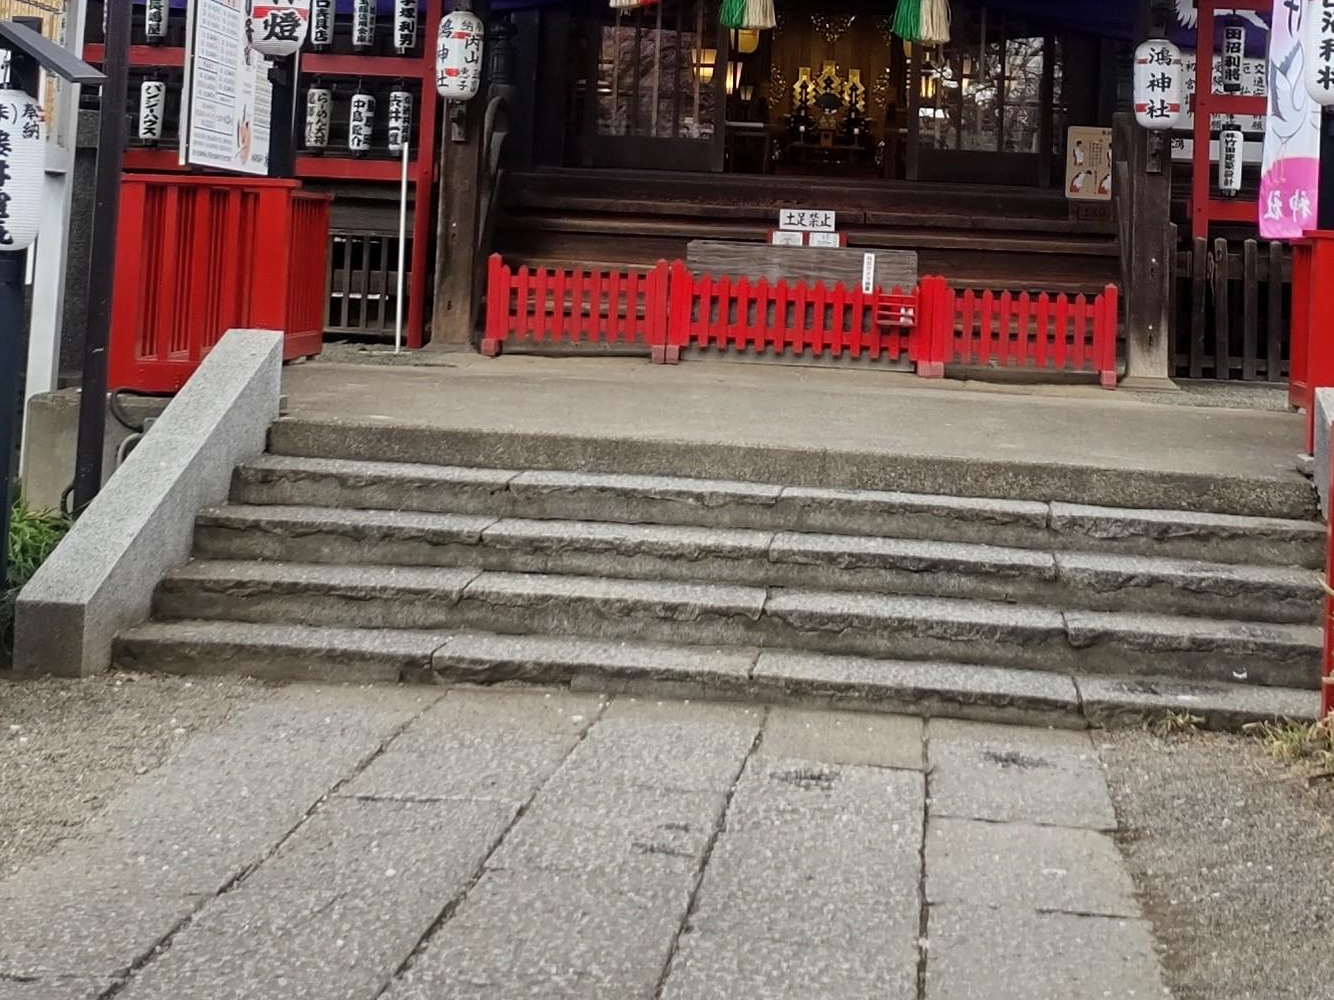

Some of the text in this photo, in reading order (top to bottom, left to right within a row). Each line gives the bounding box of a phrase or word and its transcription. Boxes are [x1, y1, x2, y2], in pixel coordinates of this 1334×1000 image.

[1147, 47, 1173, 119] 鴻神社
[783, 211, 833, 229] 土足禁止
